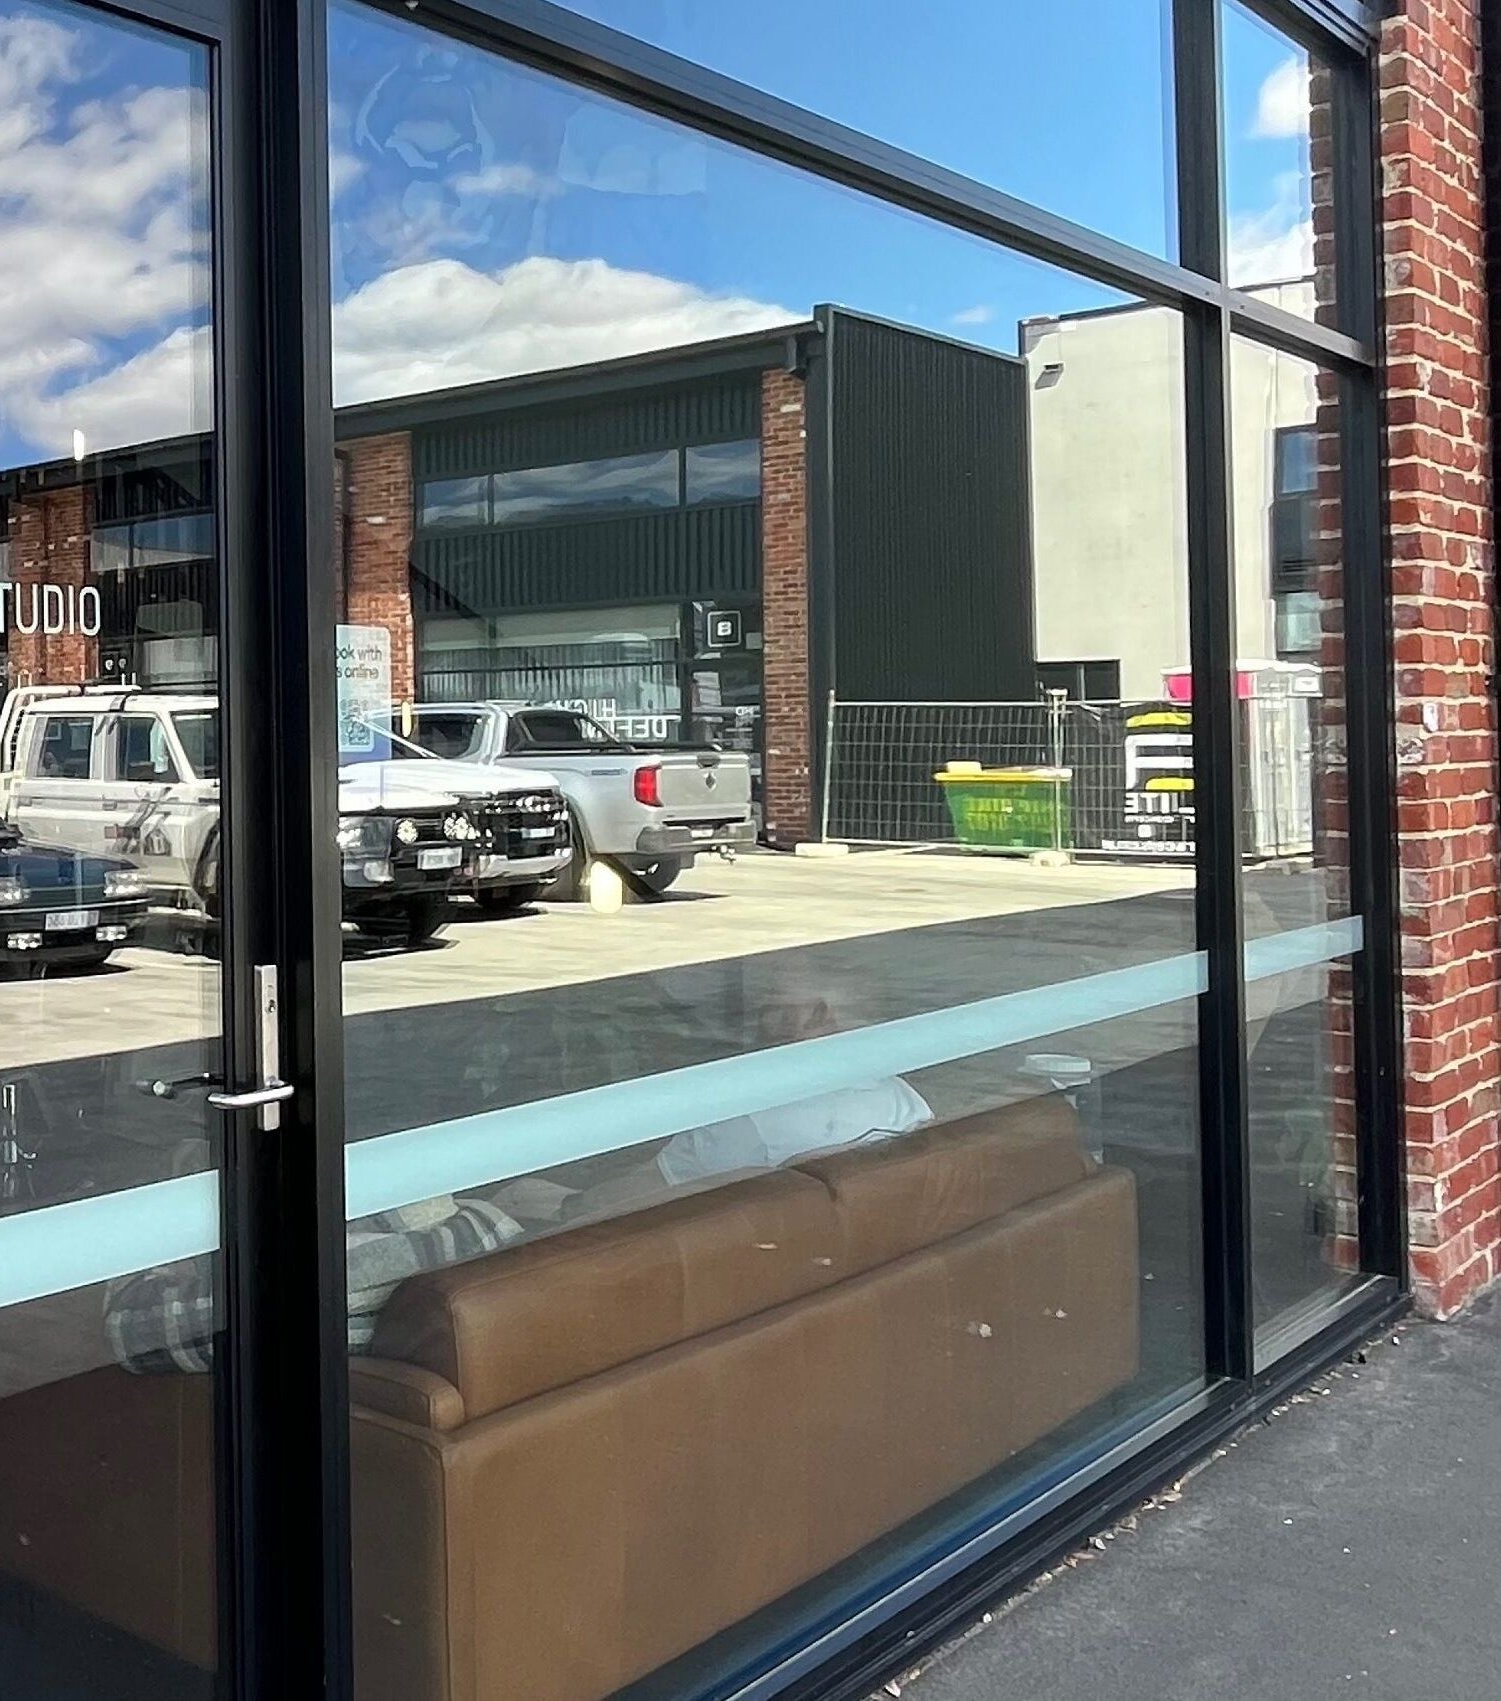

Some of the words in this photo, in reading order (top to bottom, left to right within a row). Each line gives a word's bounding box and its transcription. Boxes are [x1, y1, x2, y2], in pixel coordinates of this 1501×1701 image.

[336, 644, 355, 660] ok
[358, 644, 382, 661] with
[344, 663, 379, 679] online
